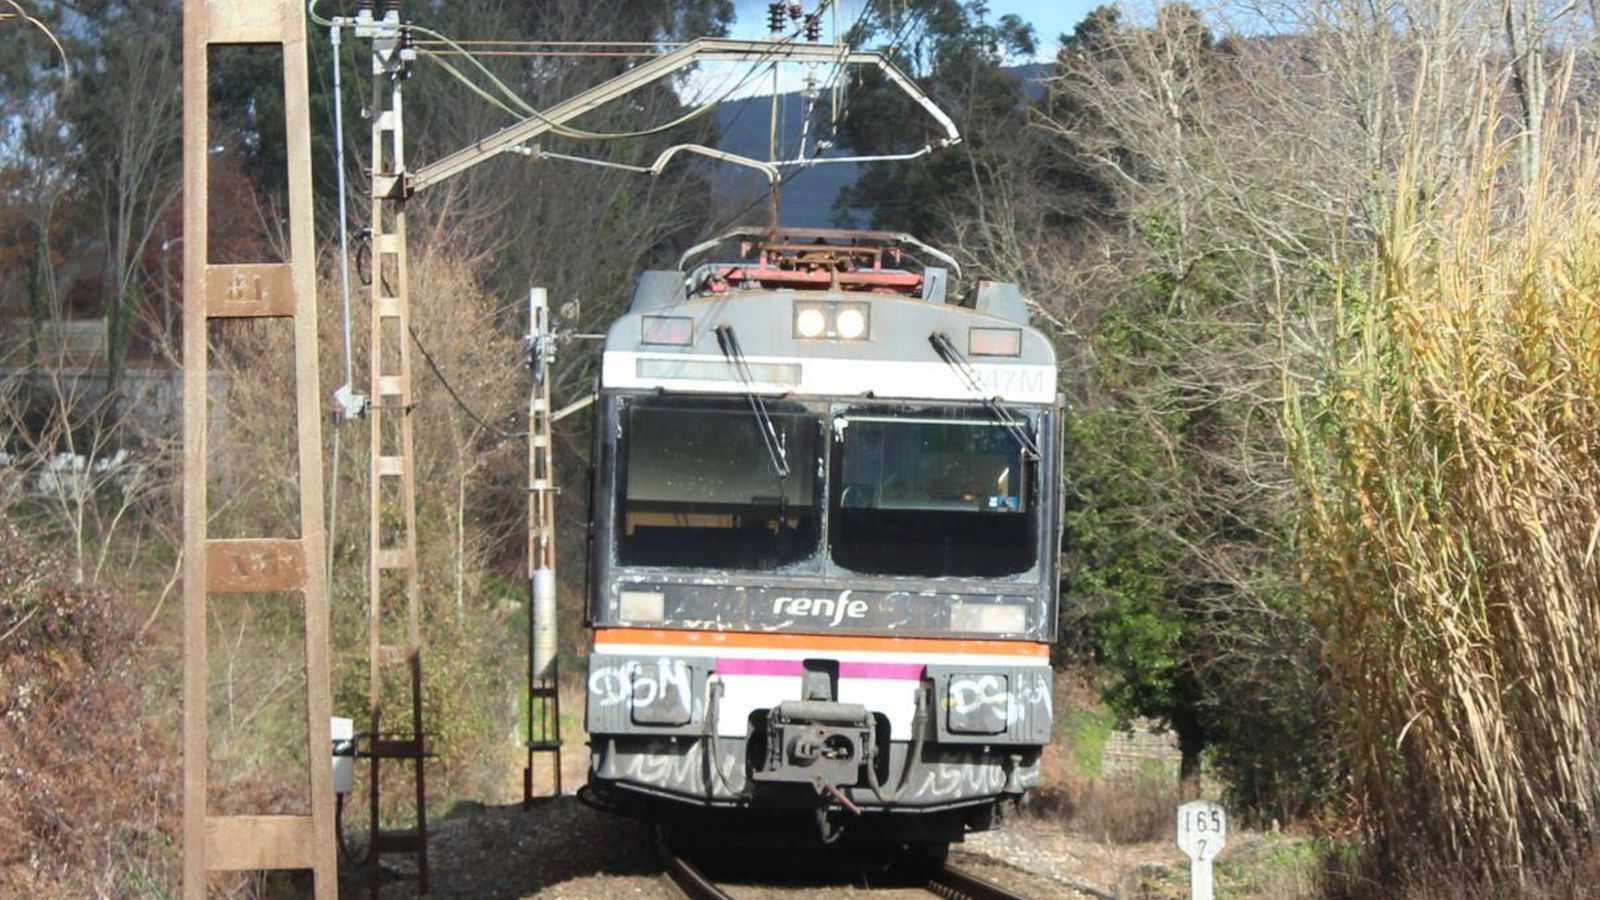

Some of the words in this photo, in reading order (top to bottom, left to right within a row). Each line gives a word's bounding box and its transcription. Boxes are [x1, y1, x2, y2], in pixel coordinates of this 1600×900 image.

[772, 589, 869, 628] renfe
[1185, 810, 1221, 833] 165
[1197, 838, 1208, 861] 2
